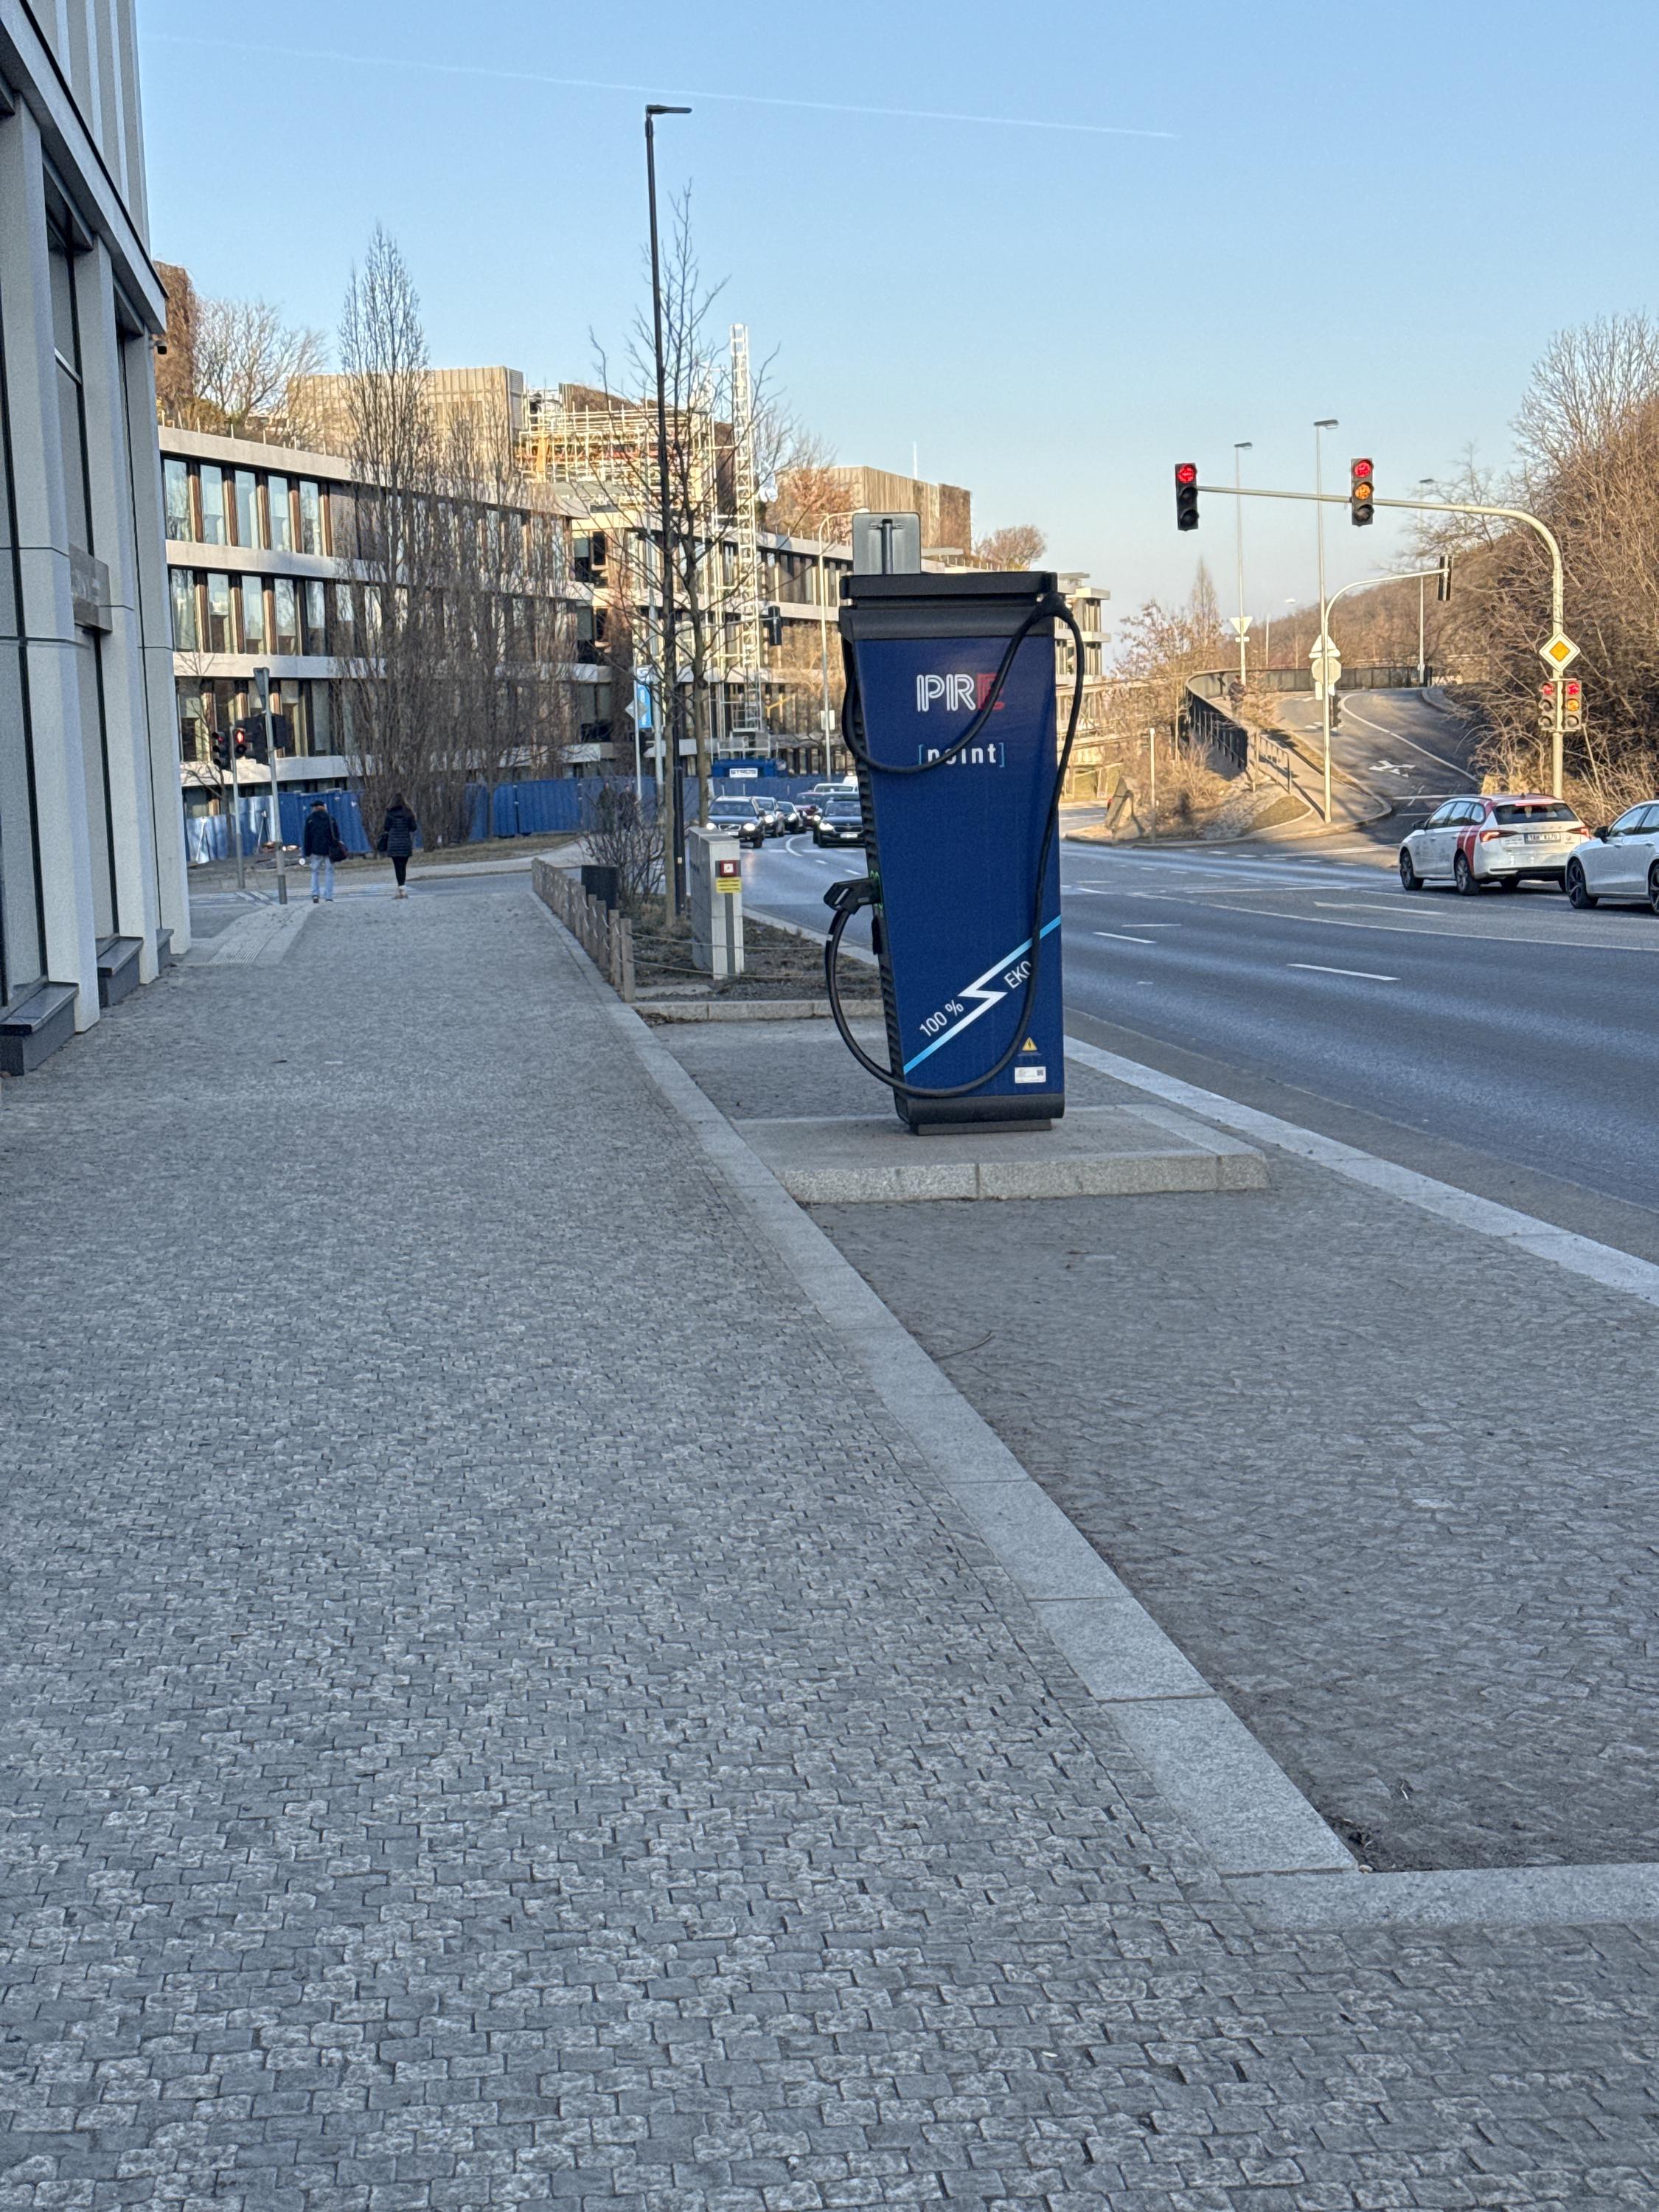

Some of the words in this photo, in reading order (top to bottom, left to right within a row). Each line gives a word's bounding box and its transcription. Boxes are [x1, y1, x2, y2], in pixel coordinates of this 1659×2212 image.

[917, 672, 1005, 712] PRE
[919, 1011, 947, 1037] 100
[945, 999, 964, 1017] %
